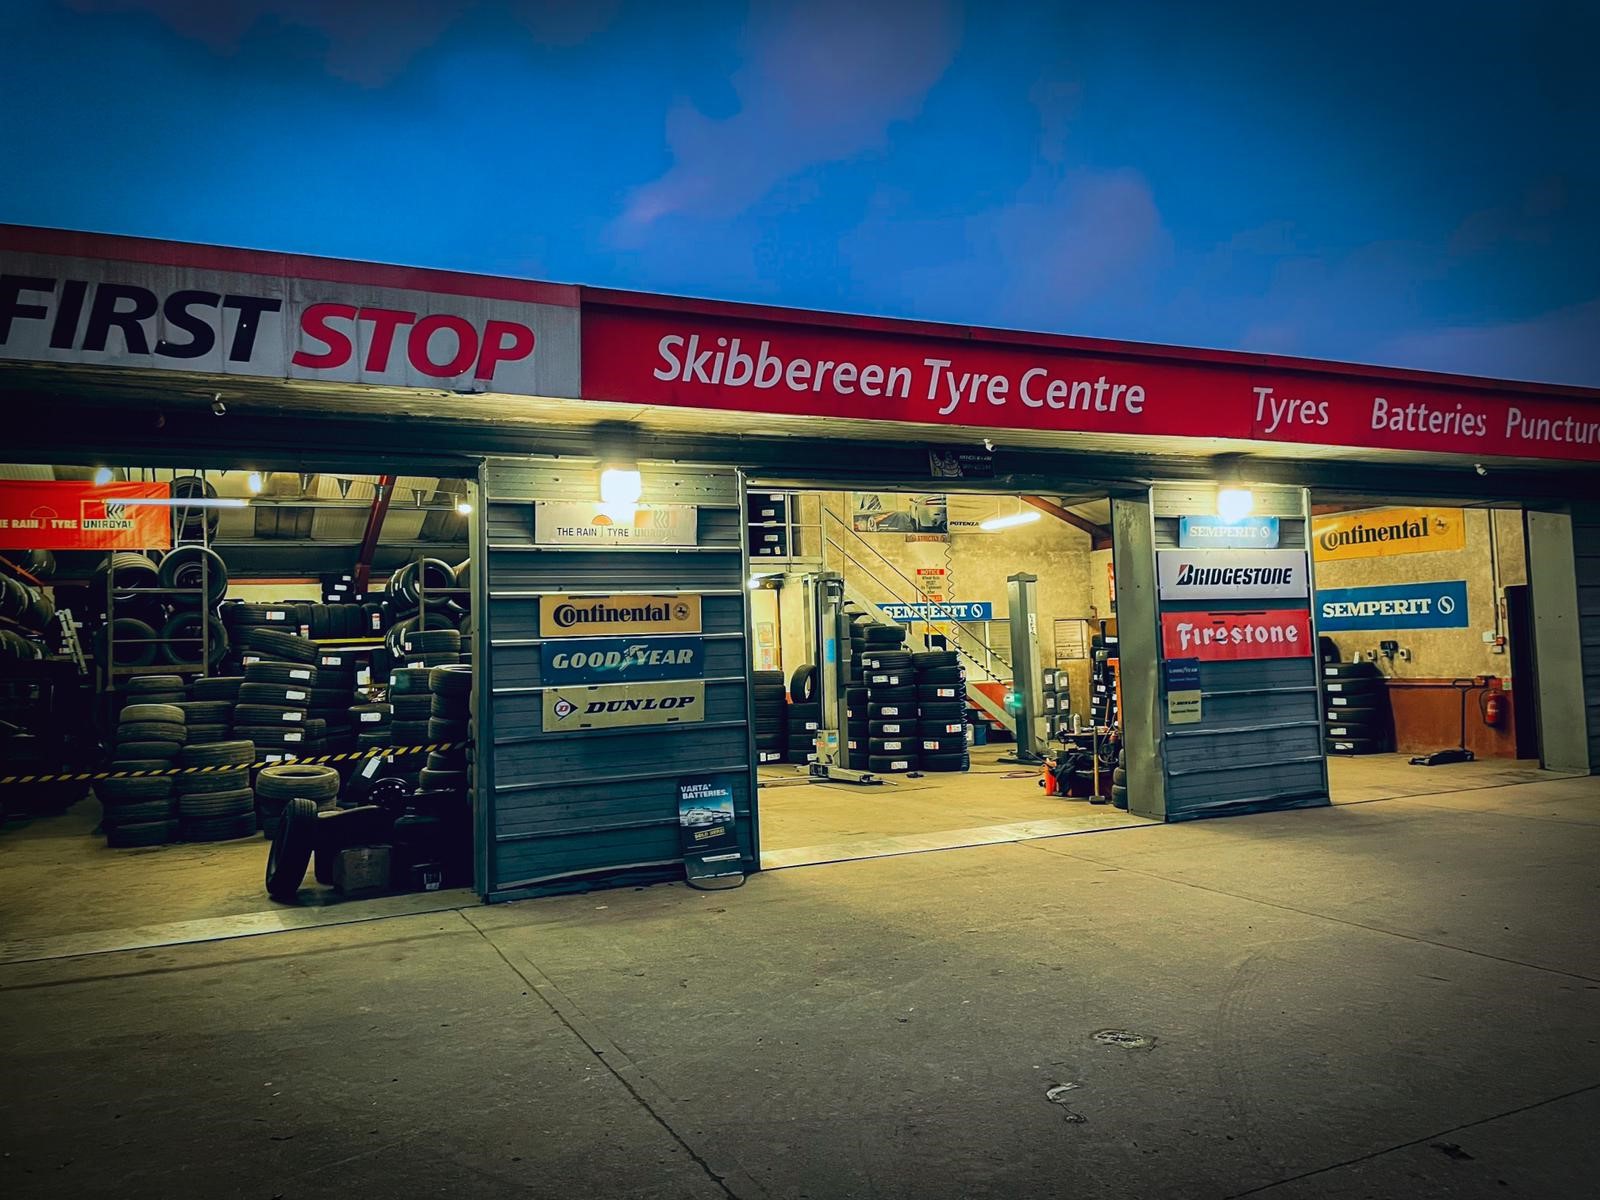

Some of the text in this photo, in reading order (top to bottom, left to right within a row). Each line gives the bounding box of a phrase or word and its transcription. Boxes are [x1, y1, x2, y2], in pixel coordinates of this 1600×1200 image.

[0, 273, 536, 380] FIRST STOP
[653, 333, 1147, 416] Skibbereen Tyre Centre
[1252, 386, 1330, 434] Tyres
[1371, 396, 1488, 438] Batteries
[12, 519, 39, 529] RAIN
[51, 519, 78, 529] TYRE
[83, 519, 133, 529] UNIROYAL
[556, 527, 629, 537] THE RAIN TYRE
[1189, 526, 1258, 538] SEMPERIT
[1320, 516, 1430, 552] Continental
[1176, 563, 1294, 586] BRIDGESTONE
[553, 602, 671, 628] Continental
[1322, 598, 1432, 619] SEMPERIT
[1176, 622, 1299, 651] Firestone
[583, 696, 696, 715] DUNLOP
[680, 784, 709, 793] VARTA
